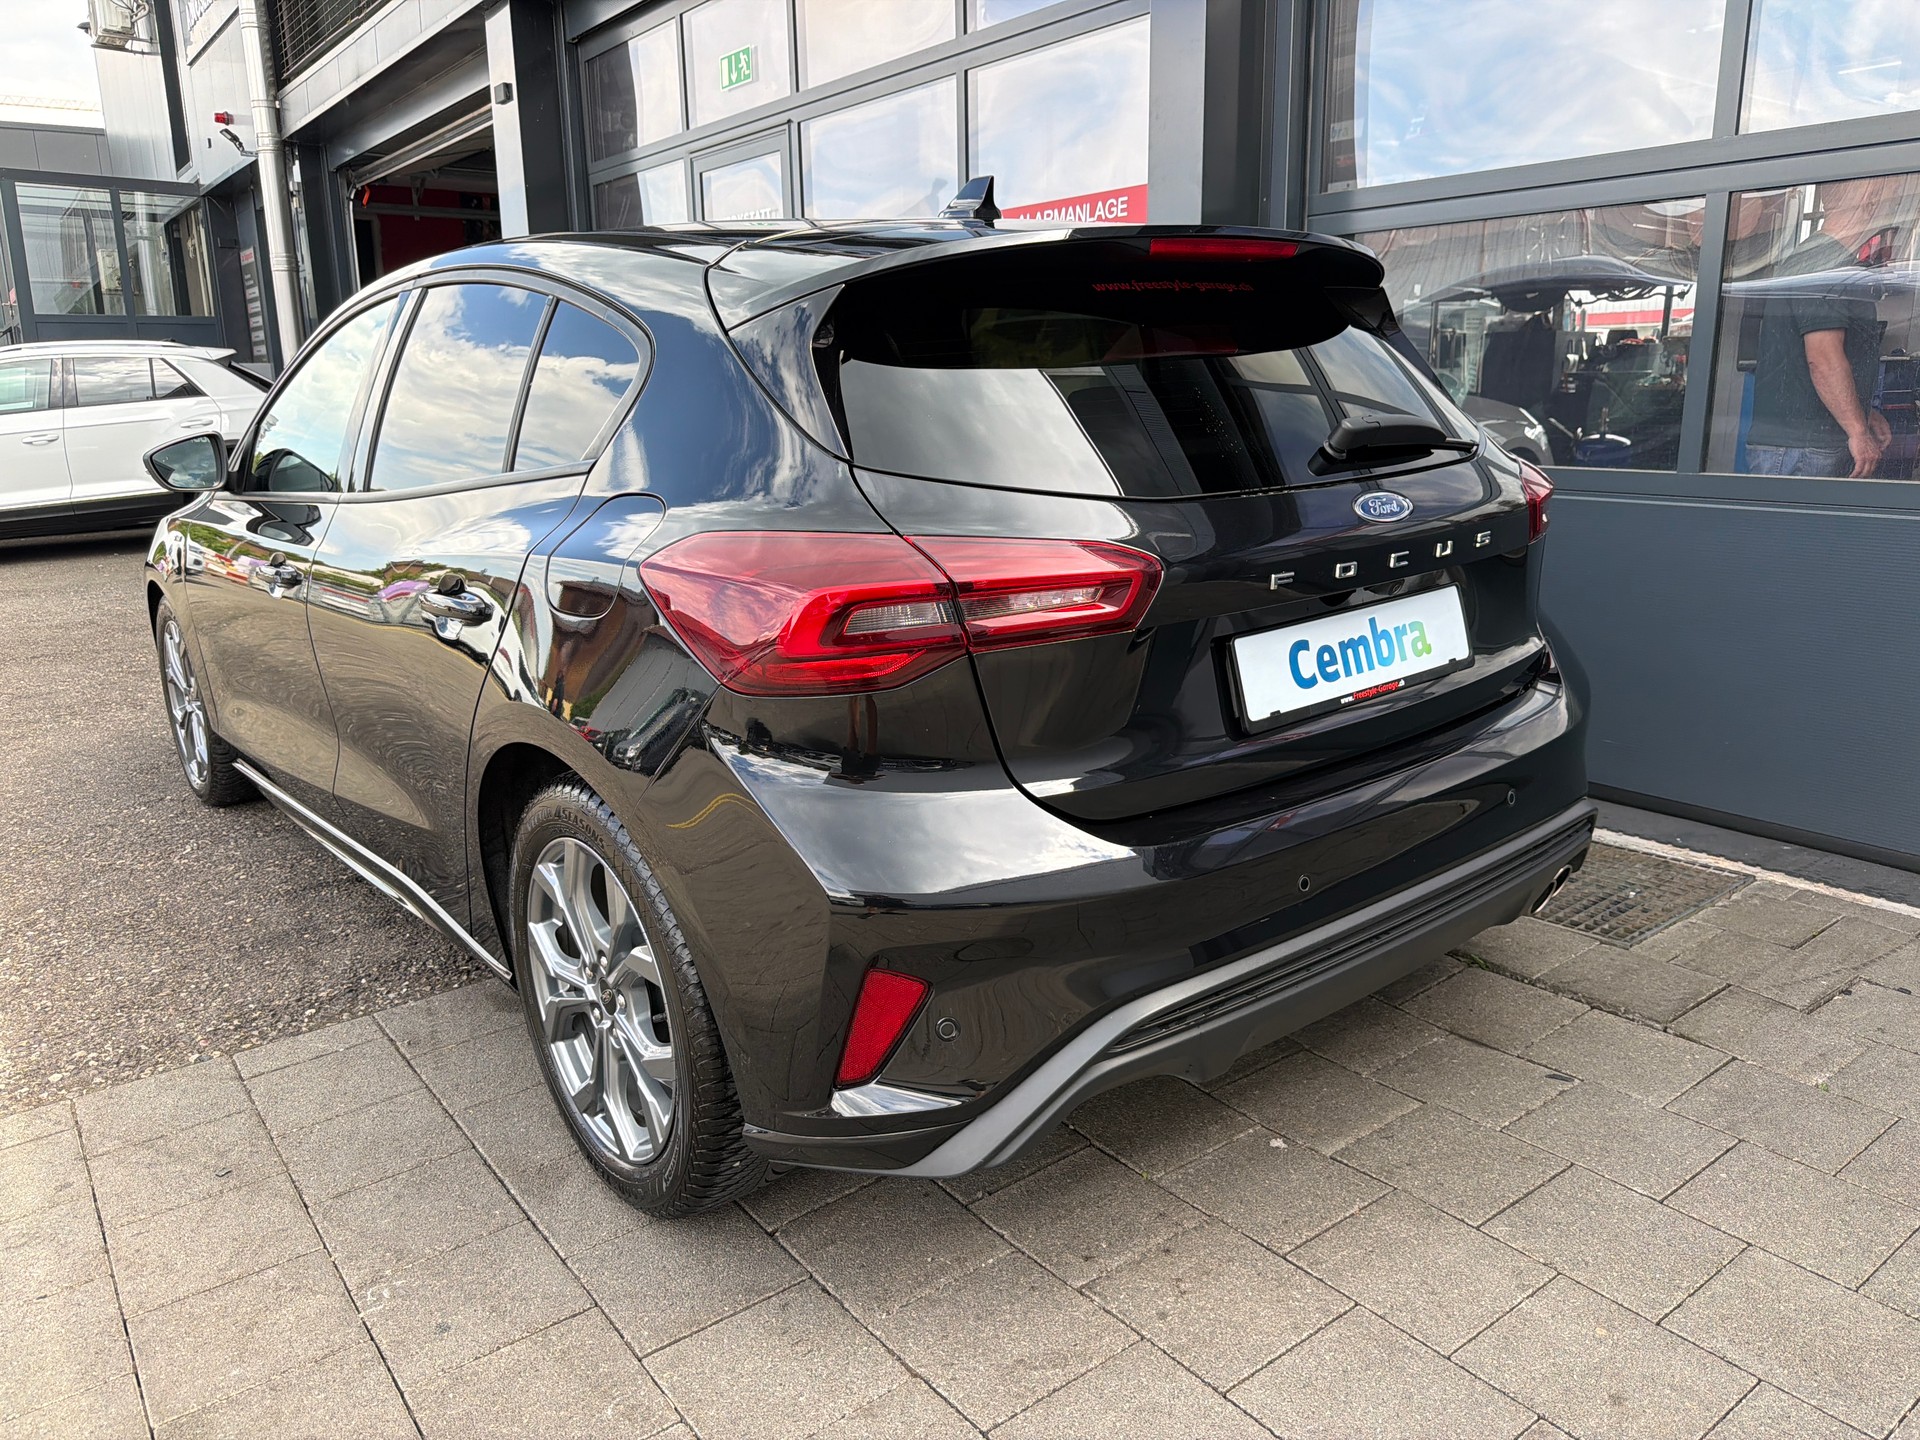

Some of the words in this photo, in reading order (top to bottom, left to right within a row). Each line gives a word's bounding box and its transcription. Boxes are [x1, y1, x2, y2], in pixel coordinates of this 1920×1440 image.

[1018, 195, 1129, 223] RMANLAGE
[1368, 497, 1401, 516] Ford
[1269, 530, 1492, 591] FOCUS
[1289, 616, 1432, 690] Cembra
